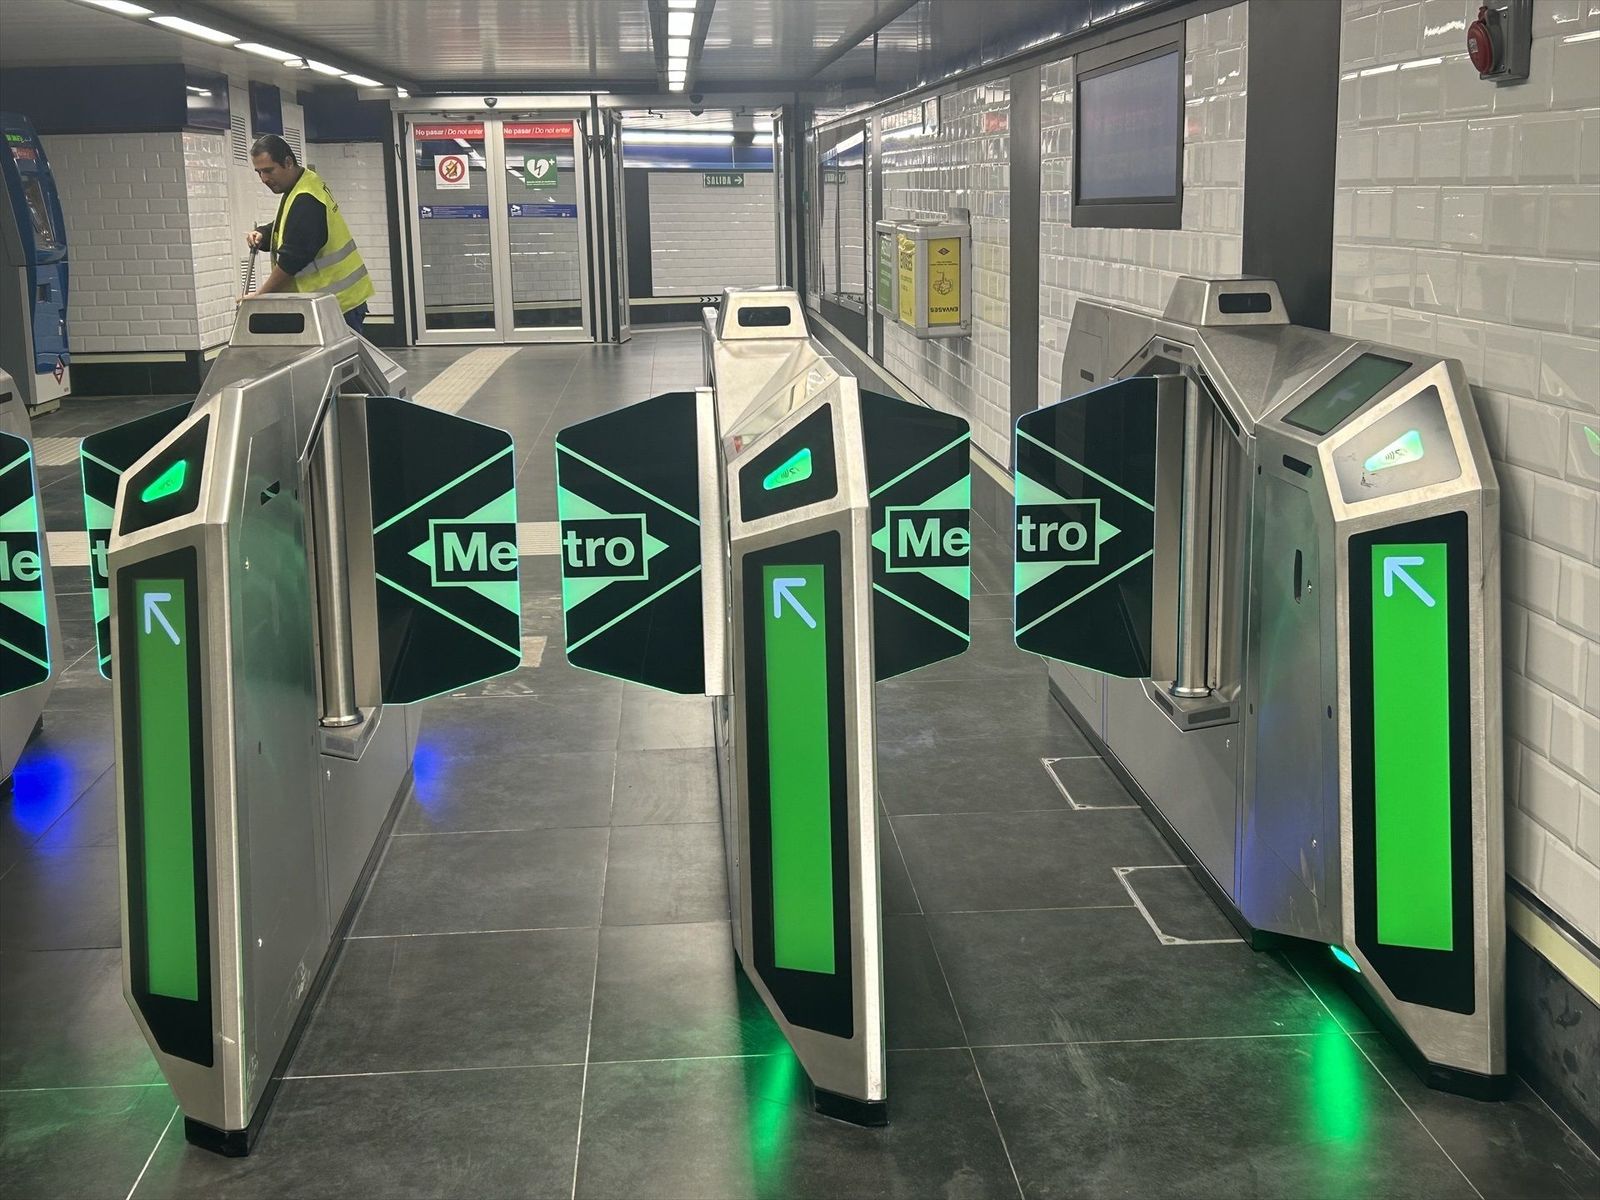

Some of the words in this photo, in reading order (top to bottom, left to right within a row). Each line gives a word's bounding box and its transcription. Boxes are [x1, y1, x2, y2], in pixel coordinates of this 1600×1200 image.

[513, 128, 531, 136] pasar
[706, 175, 732, 185] SALIDA
[442, 531, 519, 572] Me
[563, 530, 635, 568] tro
[898, 518, 970, 558] Me
[1017, 515, 1088, 552] tro
[0, 541, 41, 581] e
